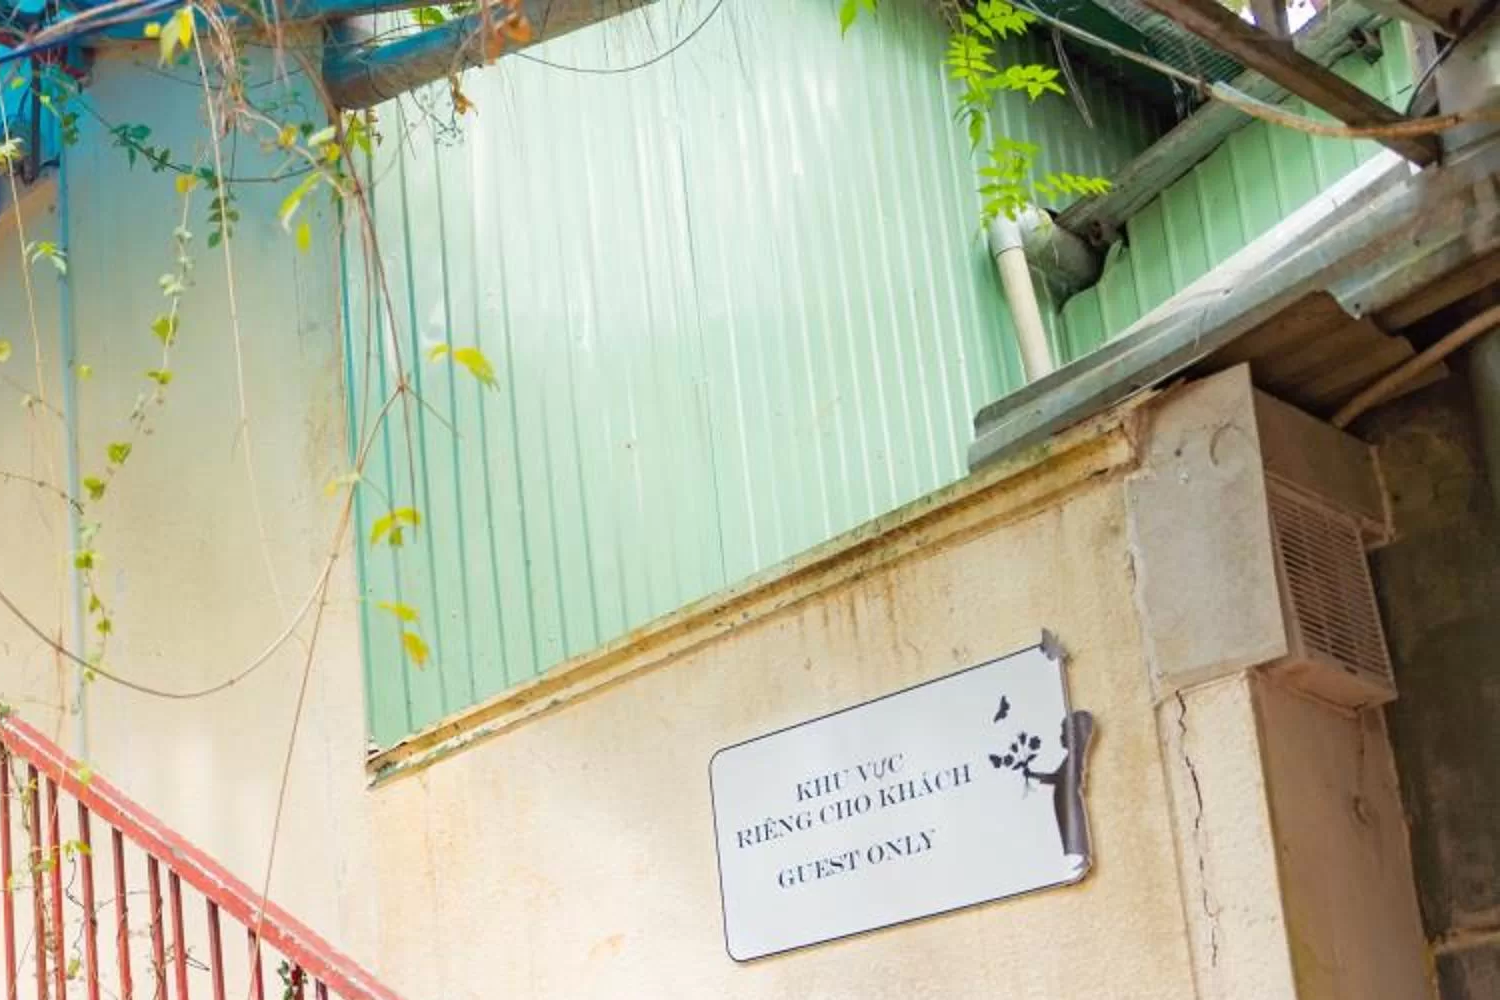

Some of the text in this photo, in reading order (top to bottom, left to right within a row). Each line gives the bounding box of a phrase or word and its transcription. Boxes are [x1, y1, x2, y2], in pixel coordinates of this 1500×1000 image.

[796, 769, 850, 802] KHU
[819, 794, 873, 825] CHO
[777, 828, 938, 889] GUEST ONLY
